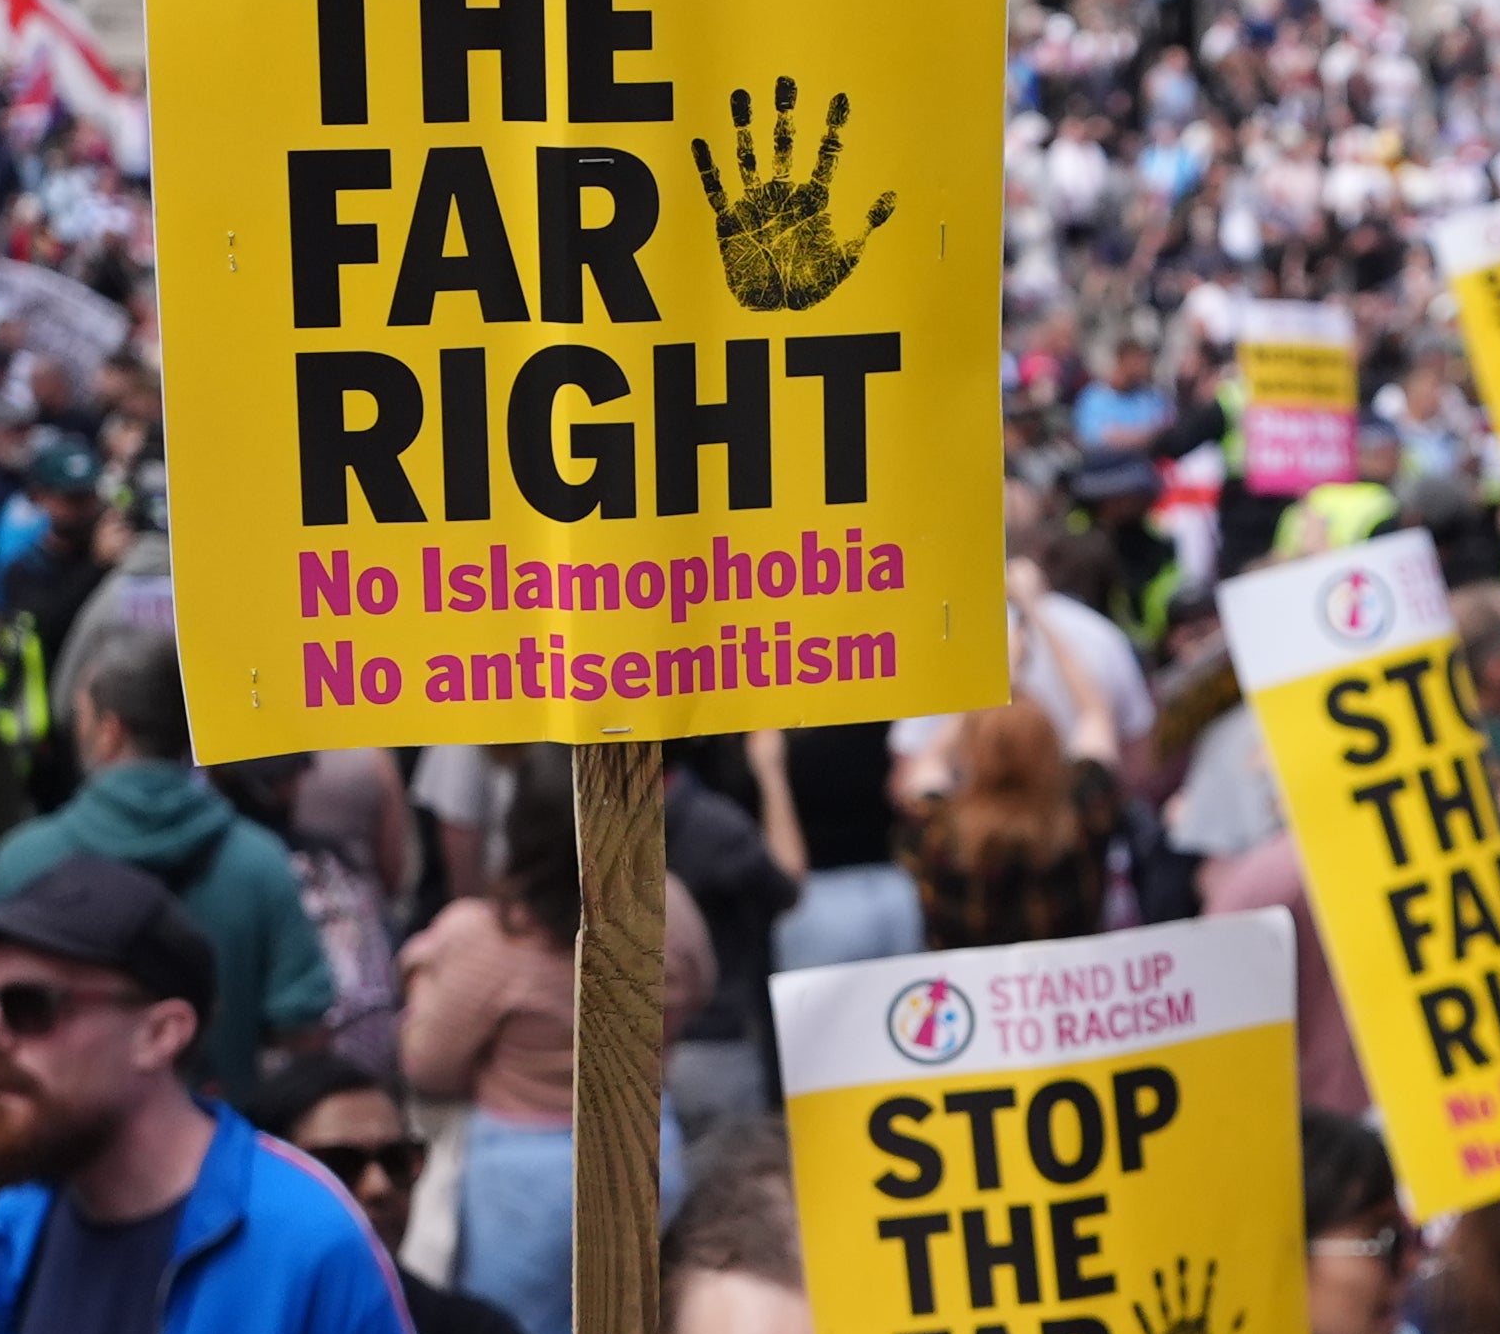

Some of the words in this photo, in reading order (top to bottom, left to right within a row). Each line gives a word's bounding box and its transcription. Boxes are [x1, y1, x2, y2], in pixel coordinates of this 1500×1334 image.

[287, 146, 662, 329] FAR
[294, 331, 902, 527] RIGHT
[299, 548, 399, 618] No
[422, 527, 905, 624] Islamophobia
[303, 638, 403, 708] No
[424, 623, 898, 704] antisemitism
[987, 963, 1116, 1013] STAND
[1125, 952, 1176, 995] UP
[994, 1013, 1044, 1056] TO
[1055, 992, 1196, 1051] RACISM
[866, 1064, 1181, 1200] STOP
[876, 1193, 1118, 1316] THE
